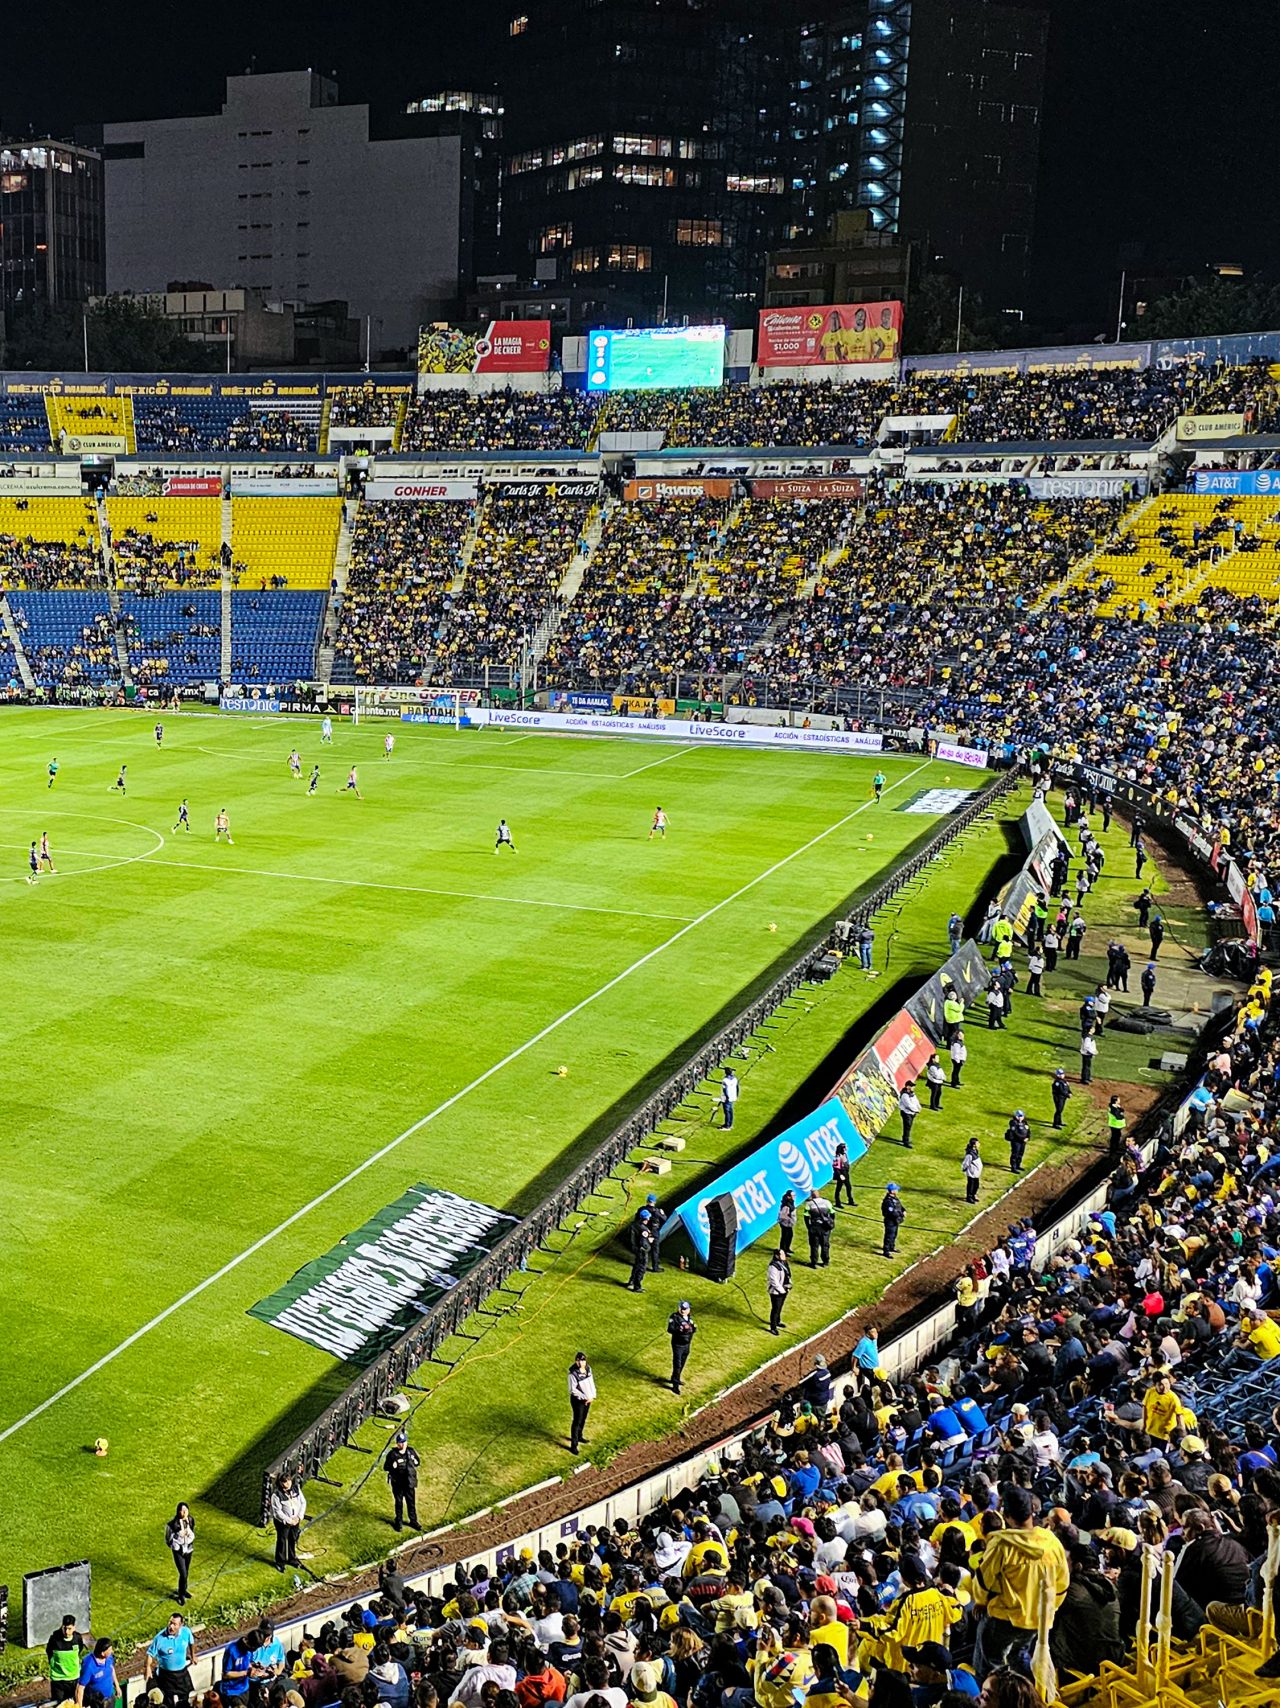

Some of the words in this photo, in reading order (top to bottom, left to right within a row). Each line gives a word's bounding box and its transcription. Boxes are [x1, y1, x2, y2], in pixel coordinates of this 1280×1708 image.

[494, 337, 502, 346] LA
[502, 337, 522, 346] MAGIA
[774, 343, 800, 351] $1,000
[494, 346, 502, 354] DE
[502, 346, 522, 354] CREER
[1198, 423, 1213, 431] CLUB
[1211, 477, 1240, 489] AT&T
[394, 486, 448, 497] GONHER
[504, 484, 528, 496] Carl's
[528, 485, 541, 497] Jr.
[558, 484, 583, 496] Carl's
[584, 484, 598, 497] Jr.
[279, 703, 321, 713] PIRMA
[489, 711, 541, 725] LiveScore
[689, 724, 746, 738] LiveScore
[774, 731, 799, 740] ACCIÓN
[803, 733, 849, 744] ESTADÍSTICAS
[804, 1117, 846, 1172] AT&T
[730, 1169, 776, 1231] AT&T
